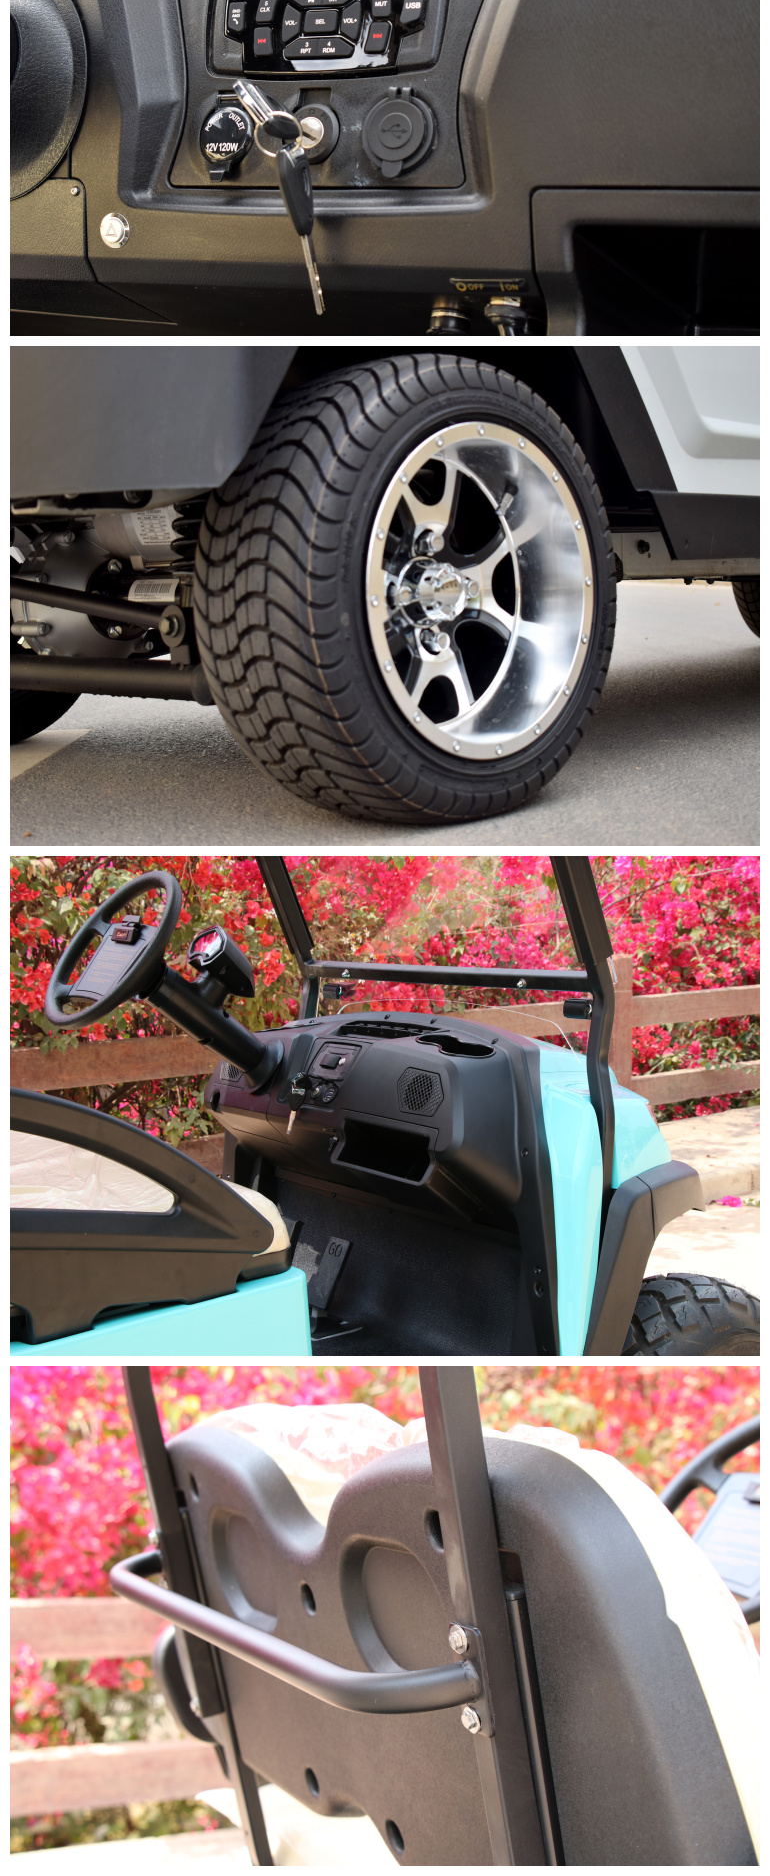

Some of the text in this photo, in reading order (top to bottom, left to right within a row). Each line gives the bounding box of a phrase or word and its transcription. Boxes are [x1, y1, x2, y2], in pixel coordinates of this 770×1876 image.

[405, 1, 421, 9] USB
[204, 112, 246, 132] POWER OUTLET
[205, 142, 239, 152] 12V 120W
[467, 283, 484, 291] OFF
[505, 283, 519, 291] ON
[328, 1242, 343, 1257] GO
